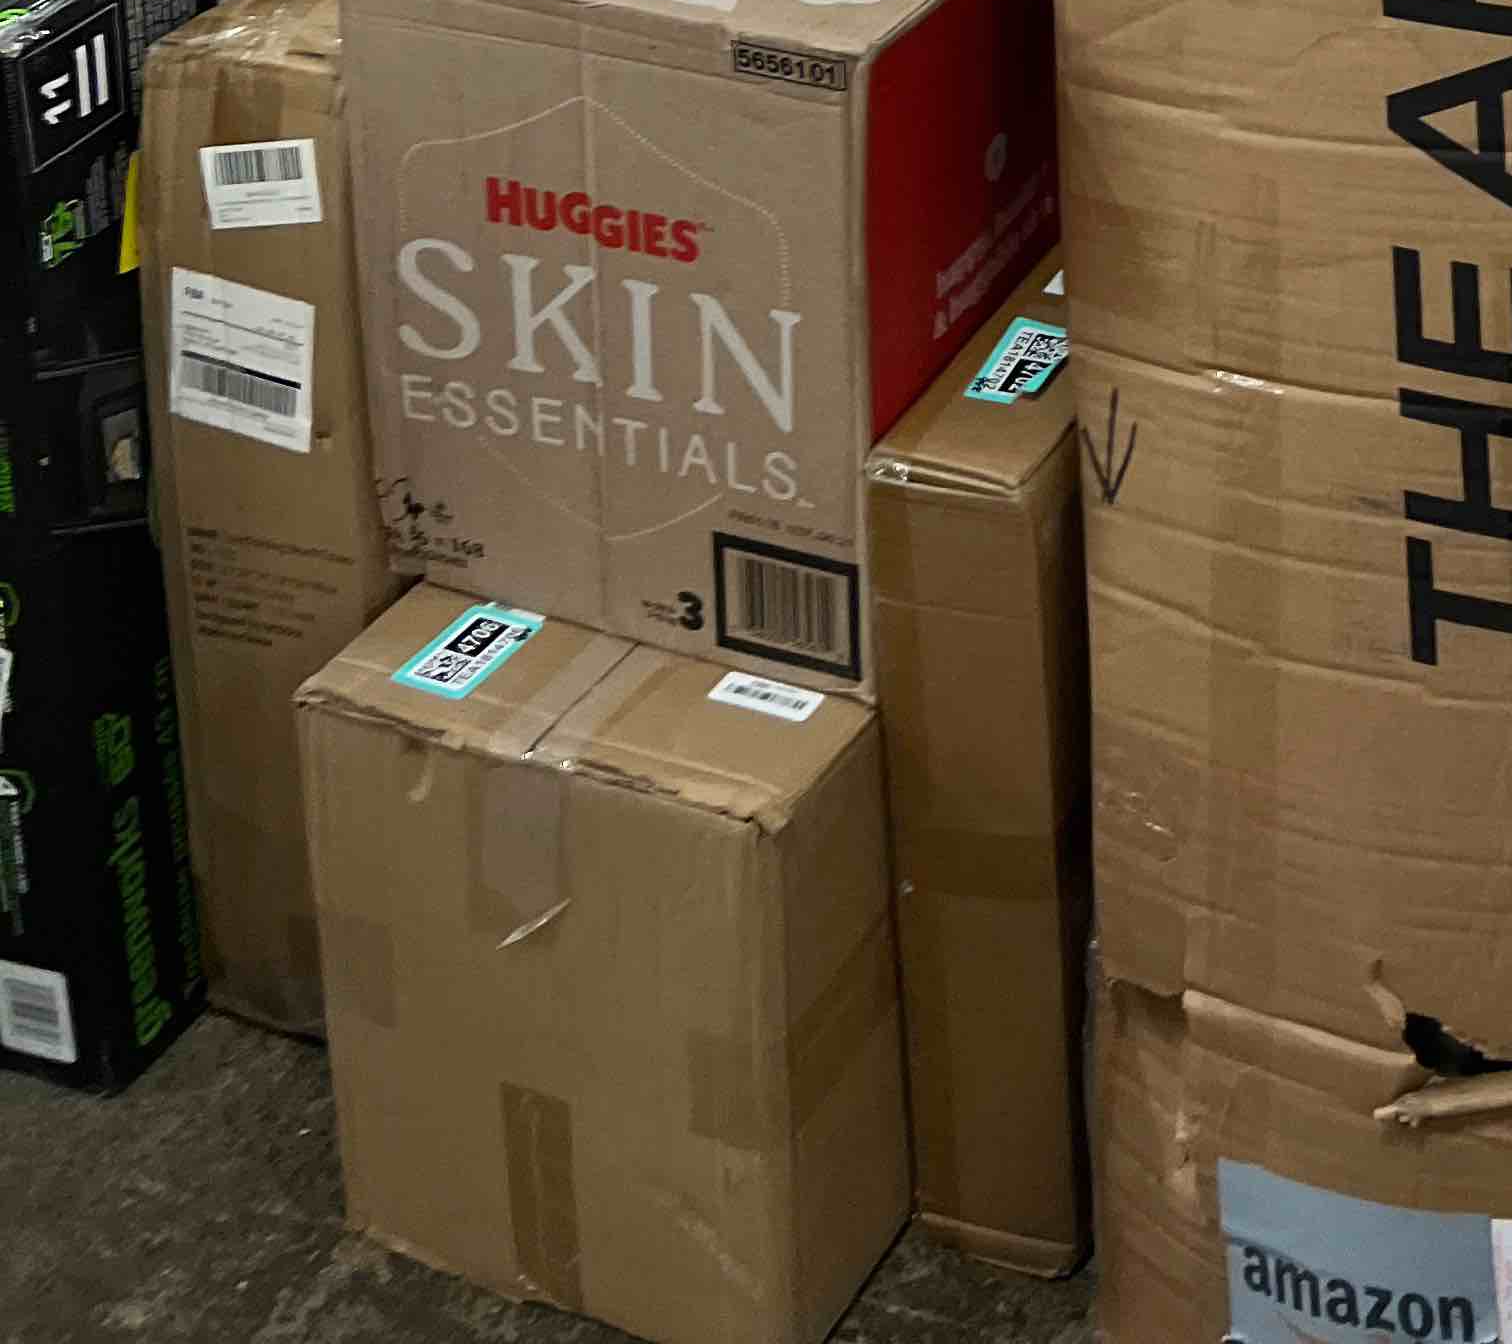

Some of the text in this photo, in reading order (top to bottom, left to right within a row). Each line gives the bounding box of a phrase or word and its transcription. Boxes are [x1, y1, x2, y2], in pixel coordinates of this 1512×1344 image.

[737, 48, 836, 85] 5656101
[484, 176, 701, 264] HUGGIES
[398, 239, 802, 433] SKIN
[400, 373, 798, 501] ESSENTIALS
[457, 622, 500, 653] 4706
[677, 591, 704, 631] 3
[1243, 1246, 1477, 1343] amazon
